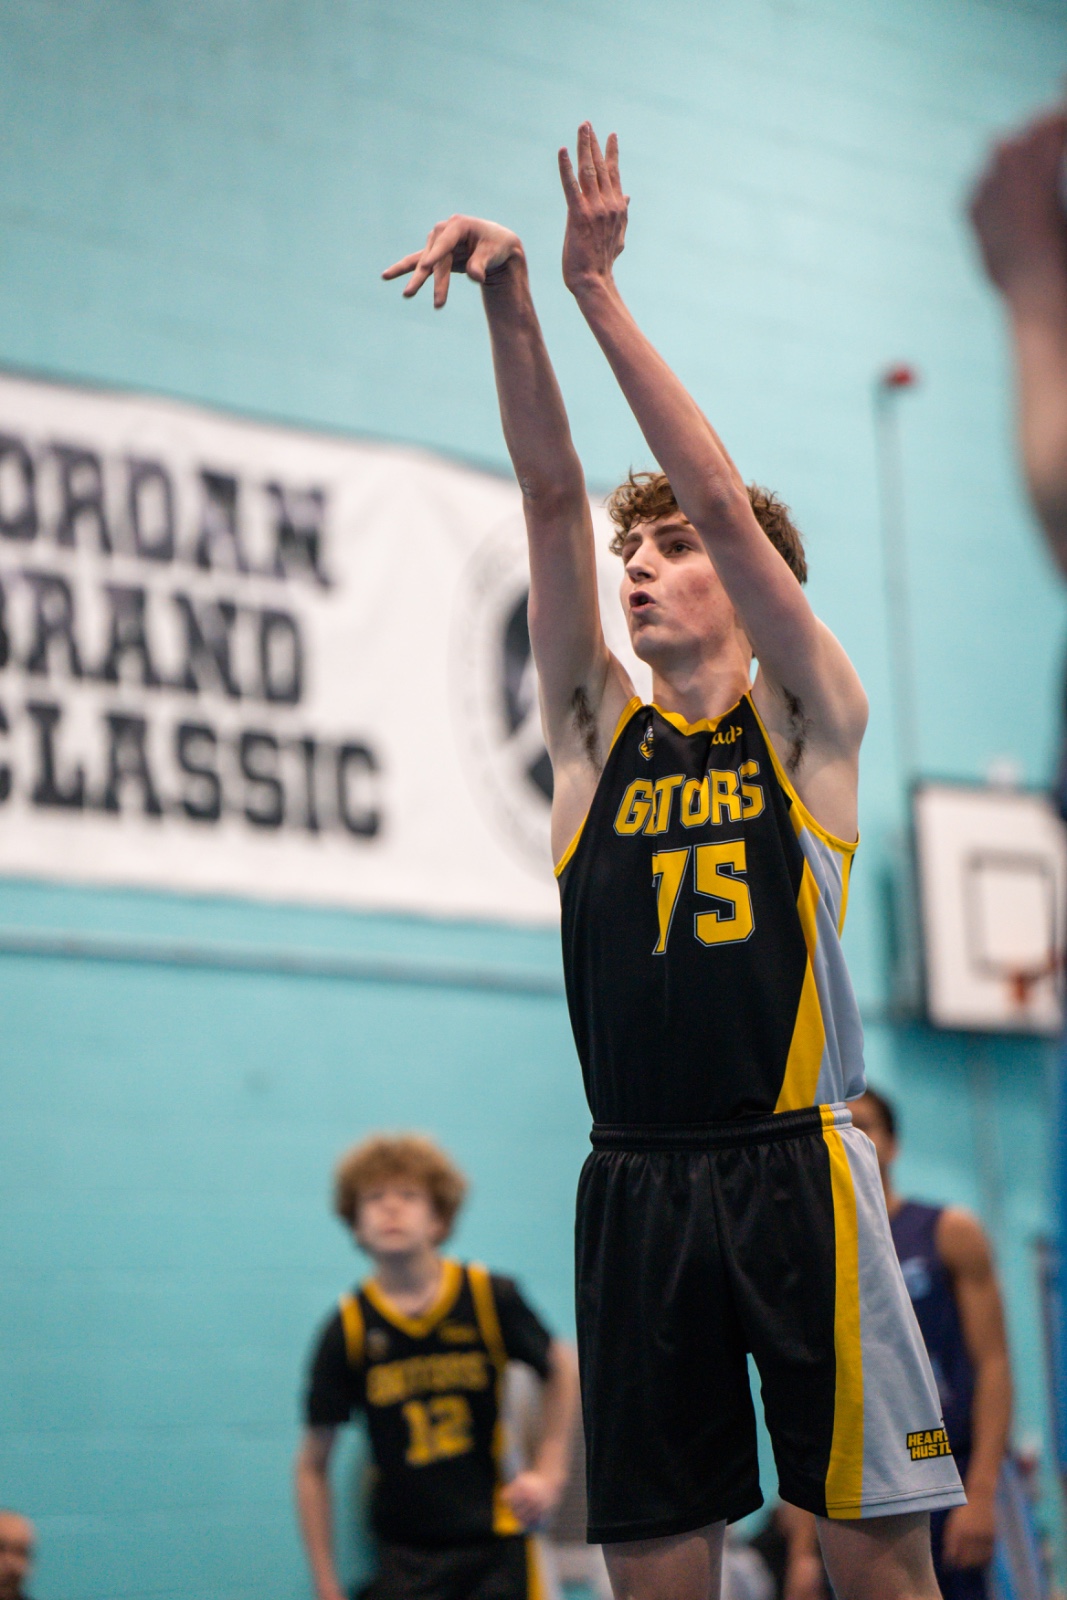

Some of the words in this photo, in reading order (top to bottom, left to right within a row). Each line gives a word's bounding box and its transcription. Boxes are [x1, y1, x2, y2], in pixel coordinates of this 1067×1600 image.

[0, 570, 307, 703] RAND
[0, 697, 381, 840] LASSIC
[652, 838, 755, 954] 75
[404, 1396, 473, 1466] 12
